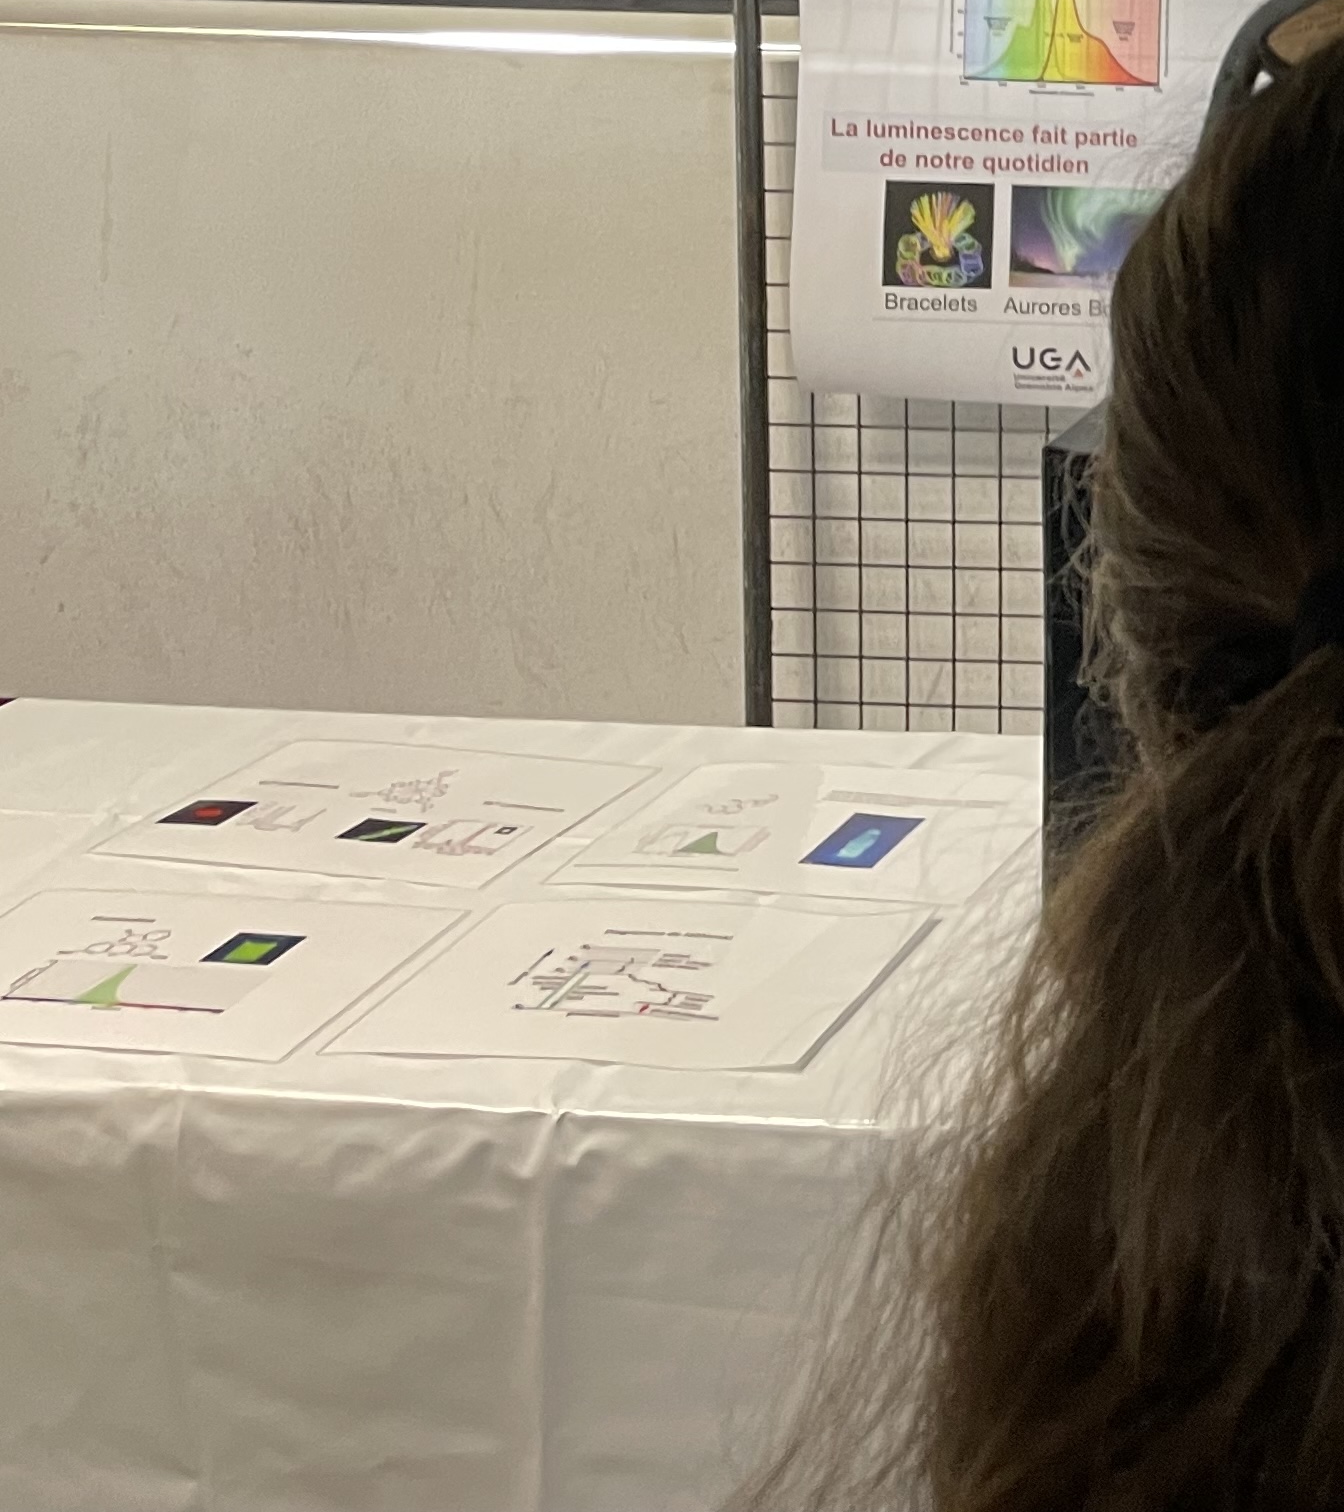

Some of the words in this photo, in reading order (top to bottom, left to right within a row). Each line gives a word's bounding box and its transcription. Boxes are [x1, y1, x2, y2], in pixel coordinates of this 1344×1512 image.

[831, 119, 857, 137] La
[867, 120, 1024, 143] luminescence
[1032, 125, 1067, 145] fait
[1075, 129, 1137, 148] partie
[880, 149, 906, 167] de
[915, 152, 974, 170] notre
[982, 154, 1089, 174] quotidien
[885, 293, 977, 312] Bracelets
[1004, 296, 1081, 316] Aurores
[1012, 347, 1091, 372] UGA
